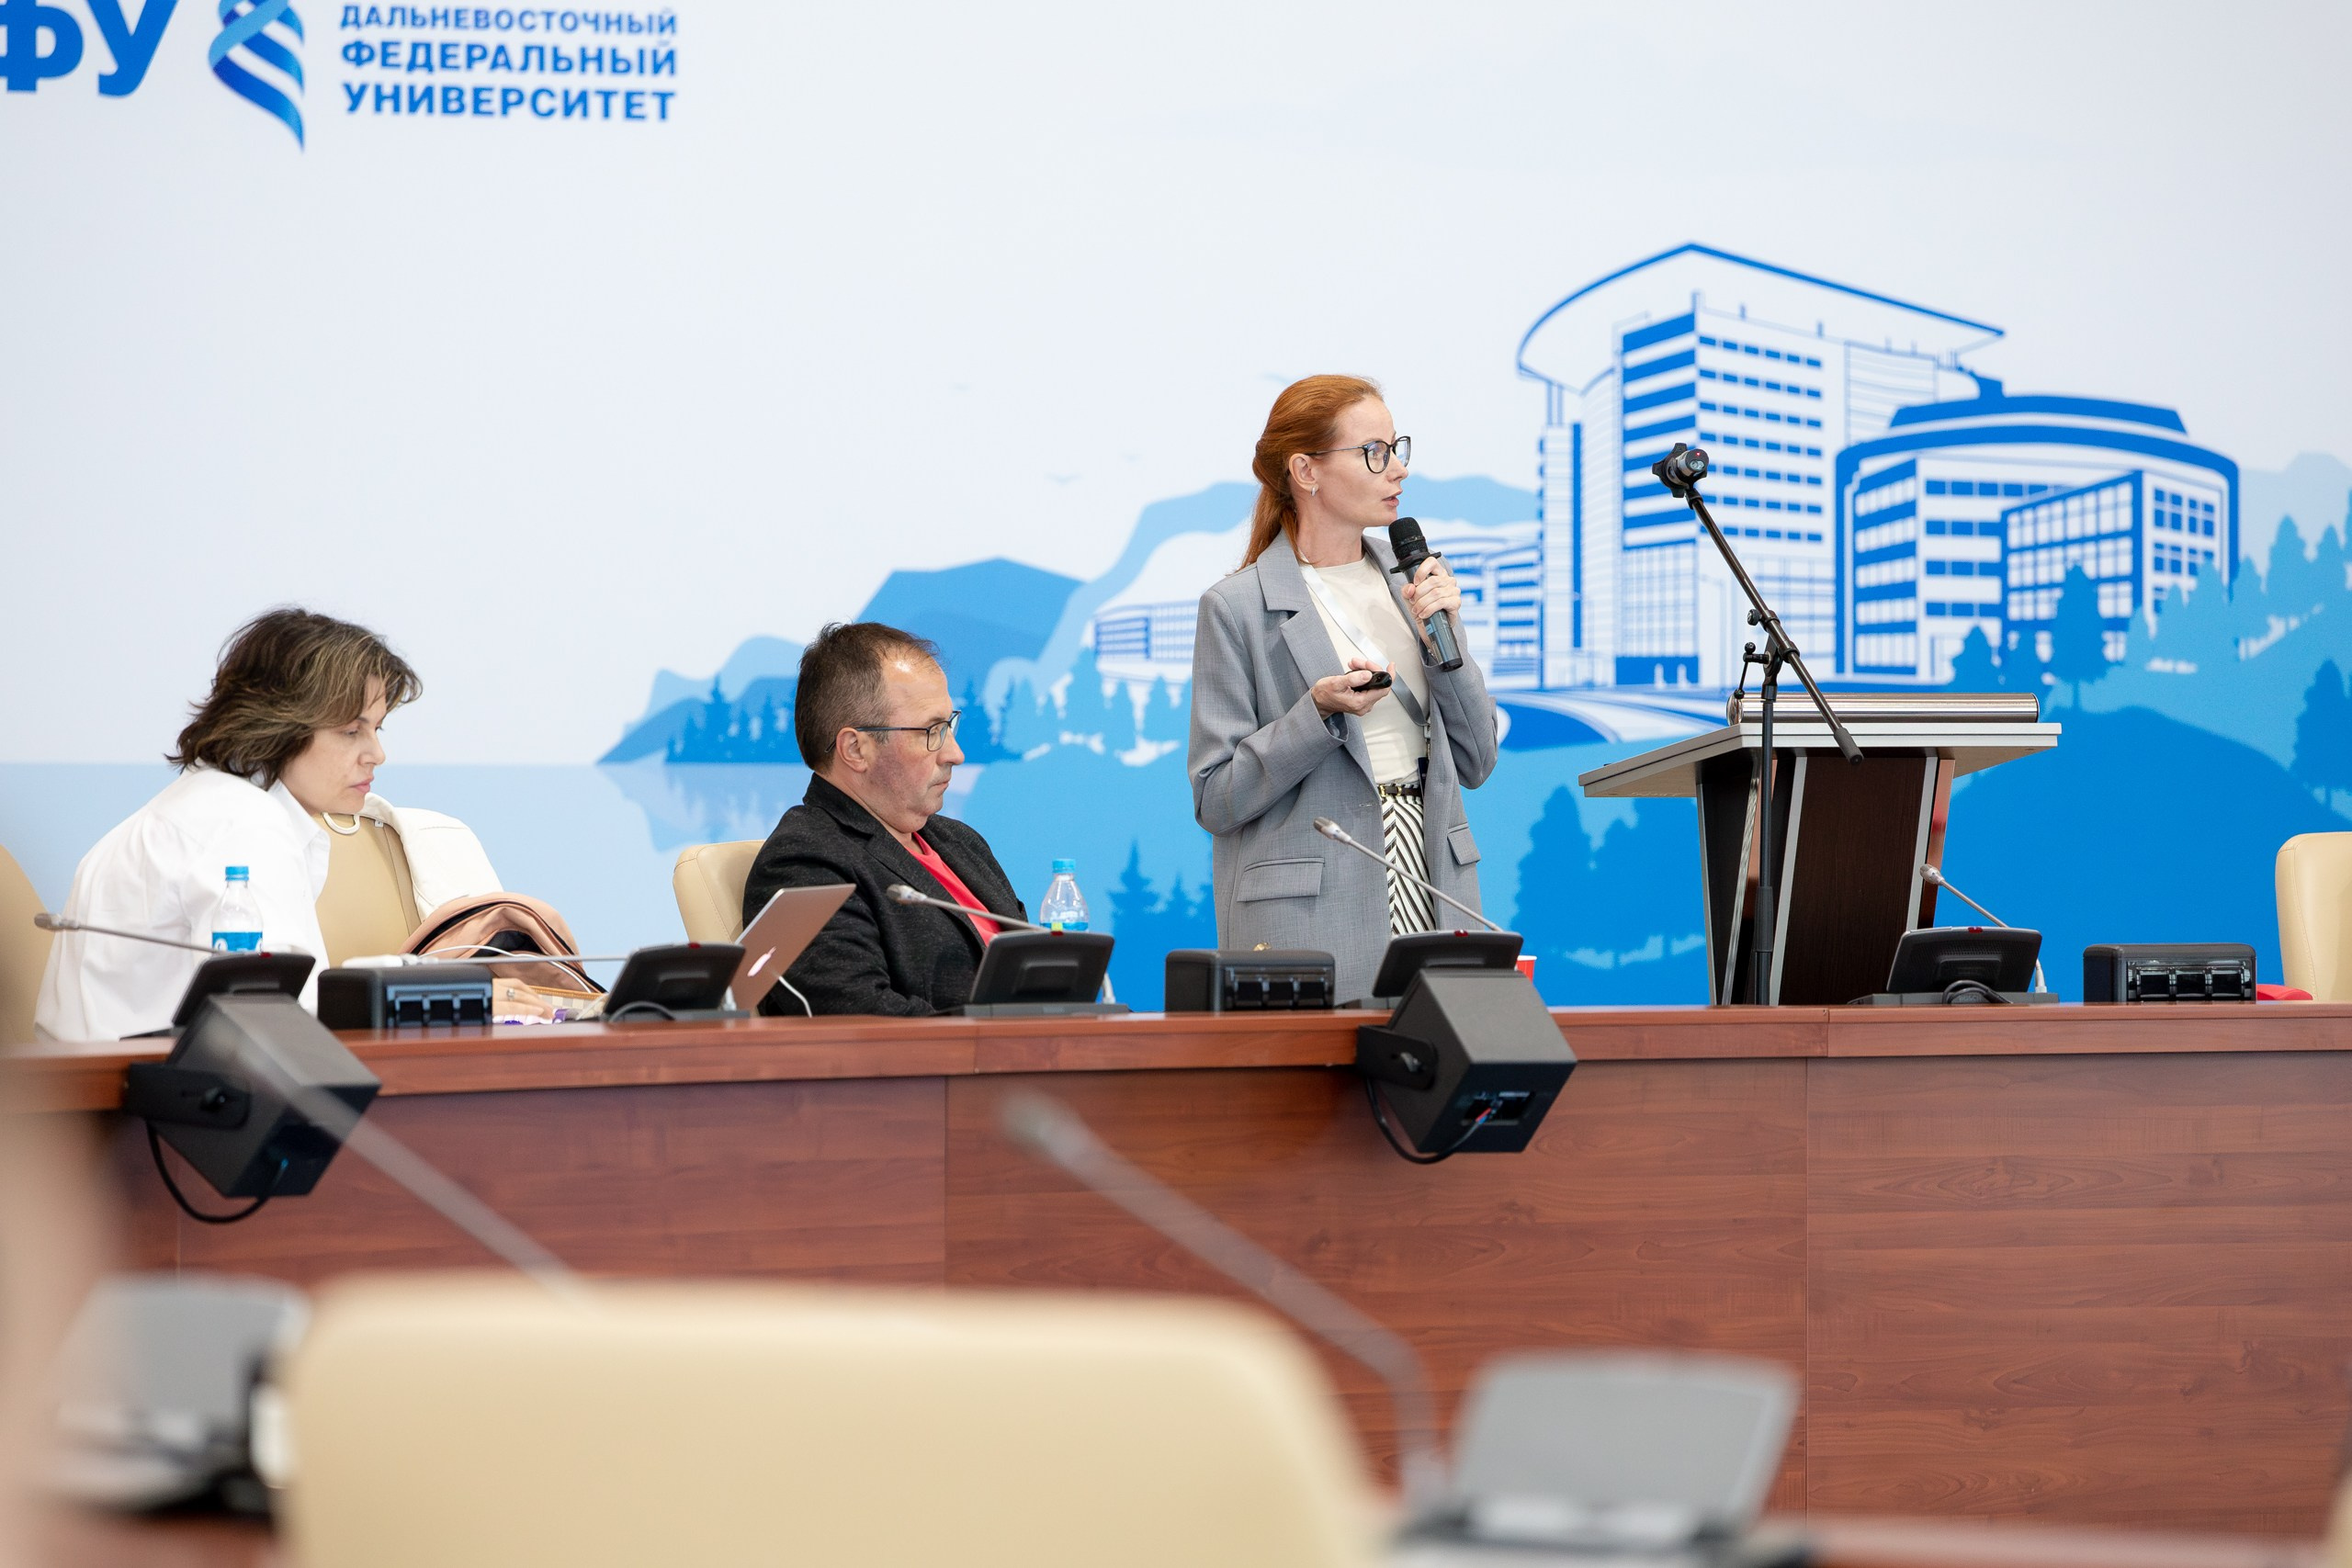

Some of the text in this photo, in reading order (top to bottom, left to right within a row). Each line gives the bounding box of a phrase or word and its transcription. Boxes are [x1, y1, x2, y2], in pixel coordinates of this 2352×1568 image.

[340, 6, 676, 35] ДАЛЬНЕВОСТОЧНЫЙ
[341, 40, 676, 76] ФЕДЕРАЛЬНЫЙ
[342, 83, 675, 120] УНИВЕРСИТЕТ
